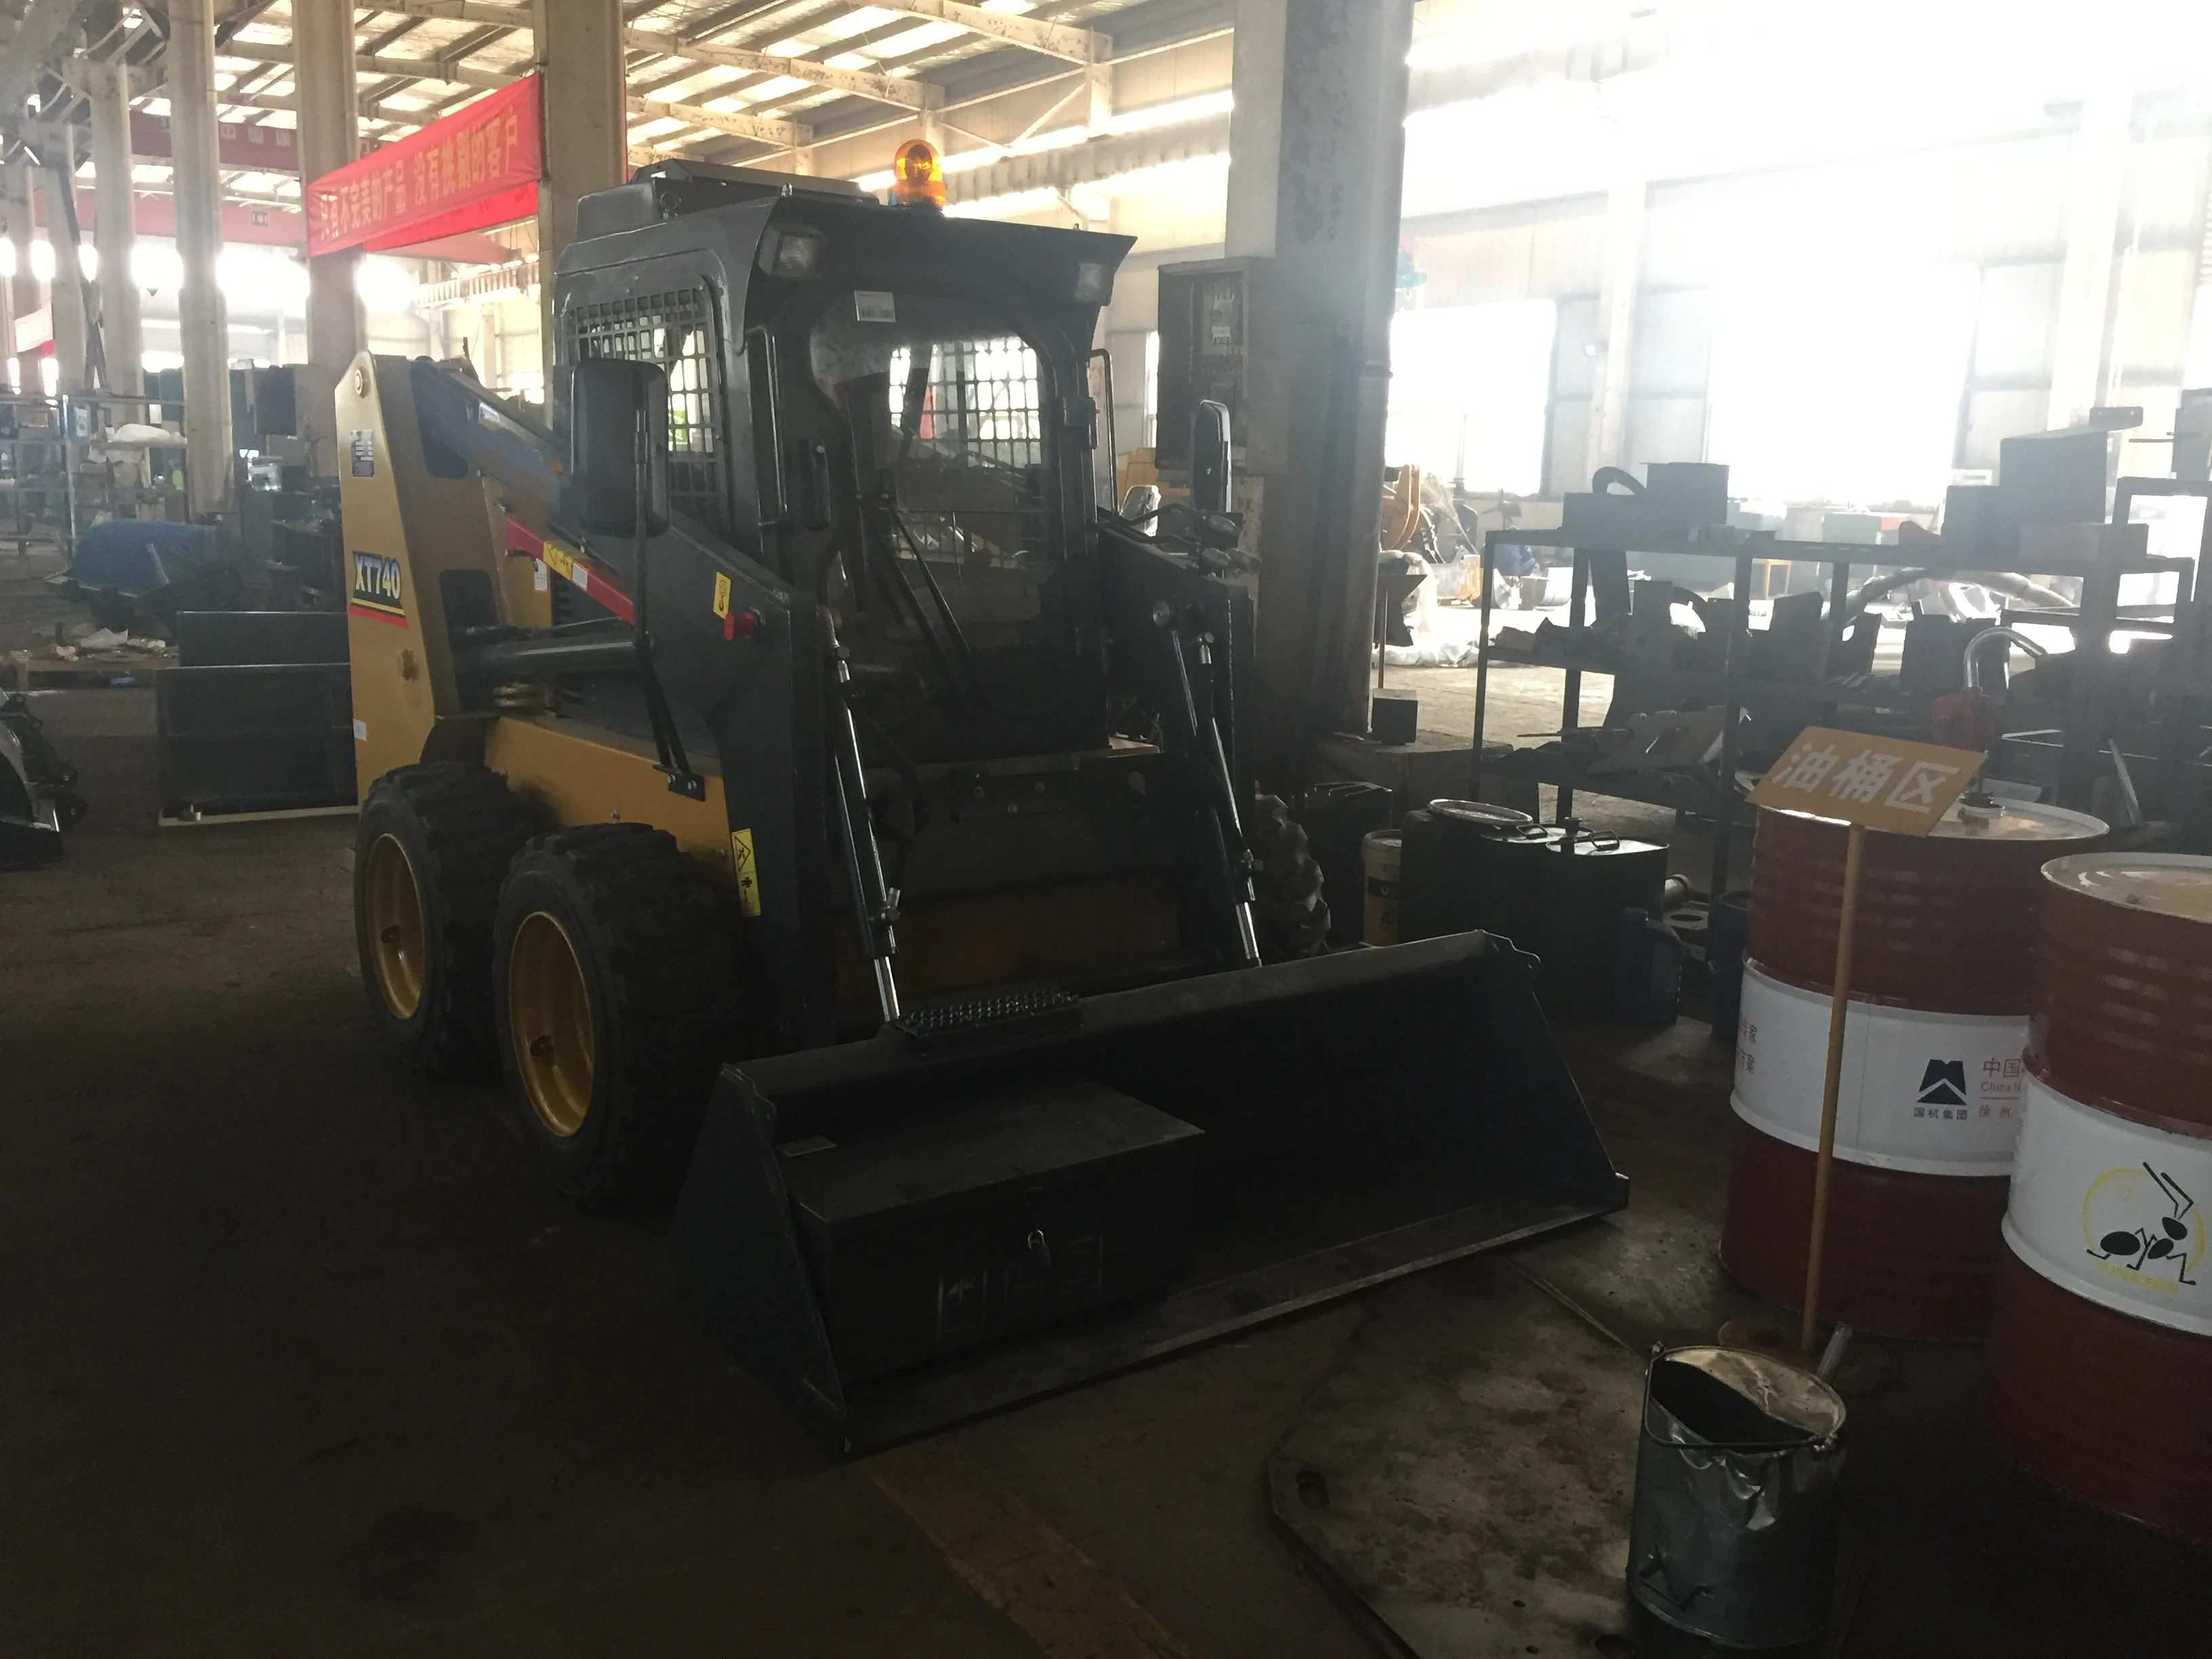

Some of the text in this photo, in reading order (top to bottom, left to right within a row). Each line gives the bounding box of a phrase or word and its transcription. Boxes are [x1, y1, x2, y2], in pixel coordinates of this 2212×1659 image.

[321, 160, 407, 241] 只有不完美的产品
[354, 554, 401, 600] XT740
[1771, 743, 1959, 814] 油桶区
[1983, 1057, 2024, 1078] 中国
[1980, 1082, 2011, 1092] China
[1913, 1107, 1968, 1121] 国机集团
